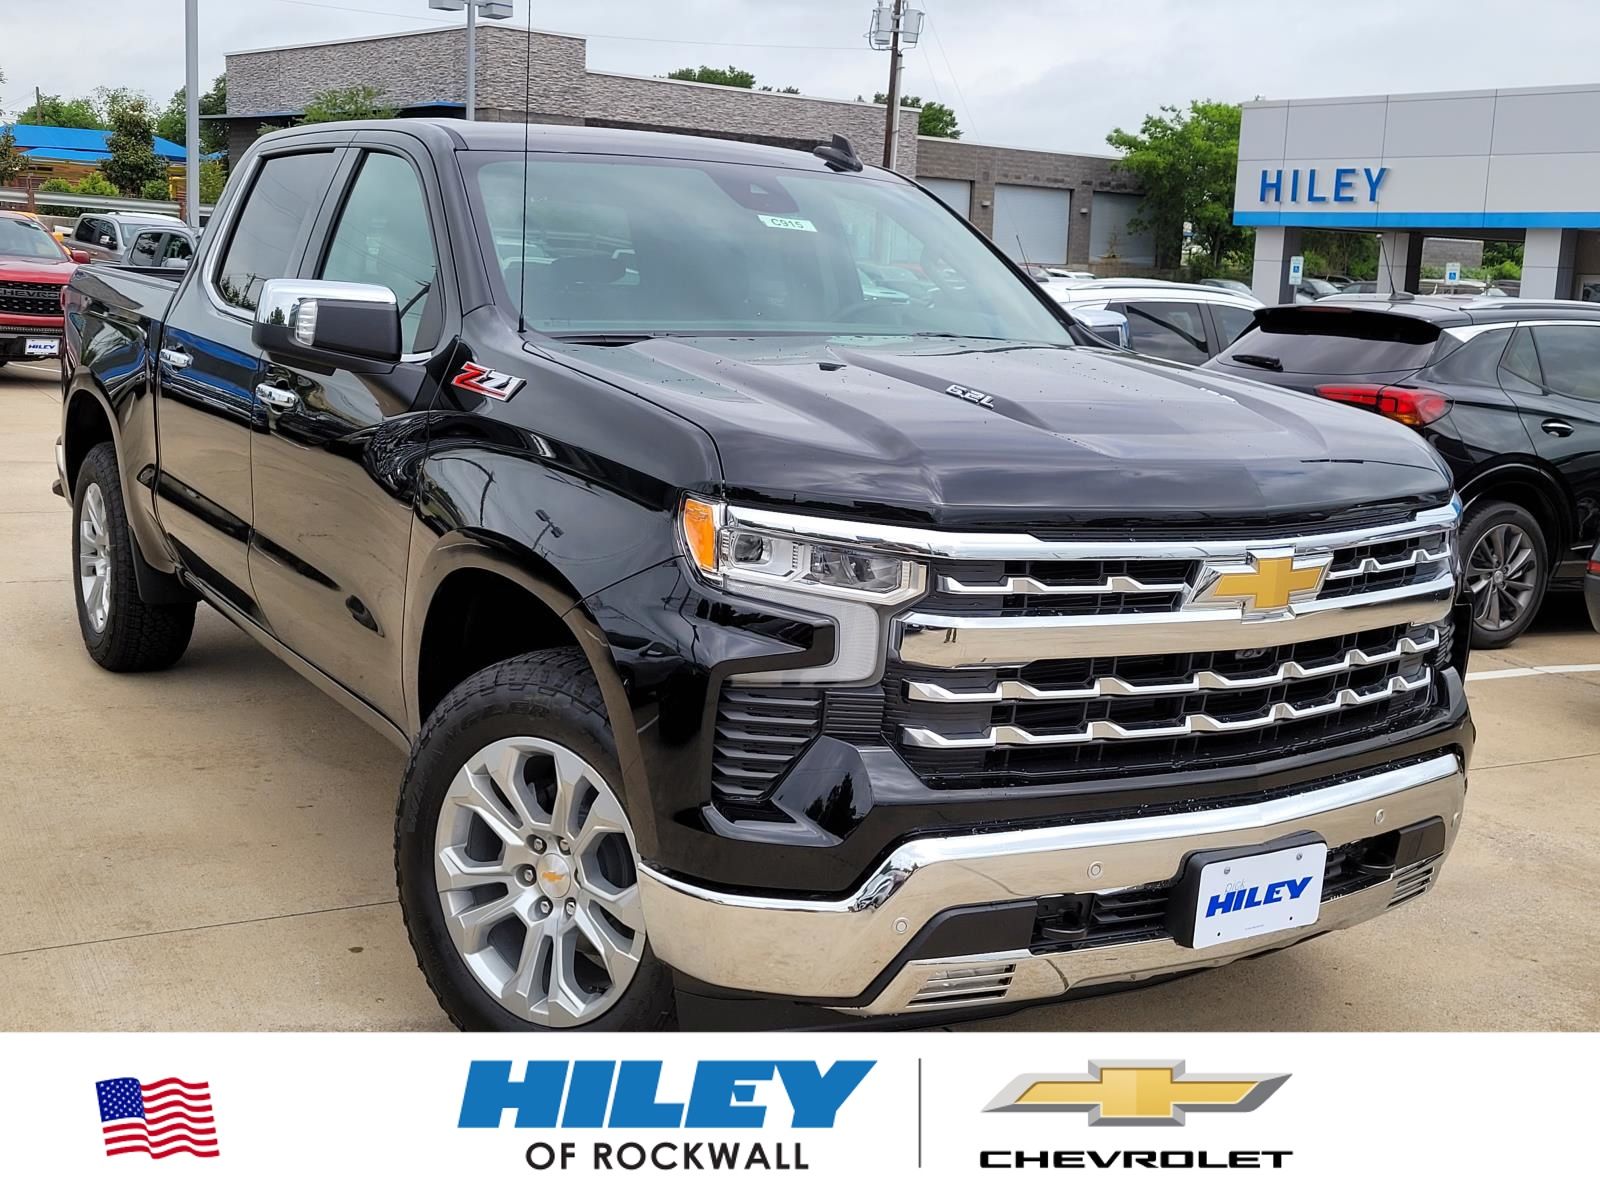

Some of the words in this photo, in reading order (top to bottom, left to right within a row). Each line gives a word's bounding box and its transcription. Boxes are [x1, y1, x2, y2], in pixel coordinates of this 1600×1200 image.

[1259, 168, 1387, 202] HILEY
[771, 218, 804, 229] C915
[451, 361, 527, 403] Z71
[945, 384, 994, 409] 6.2L
[1205, 876, 1313, 918] HILEY
